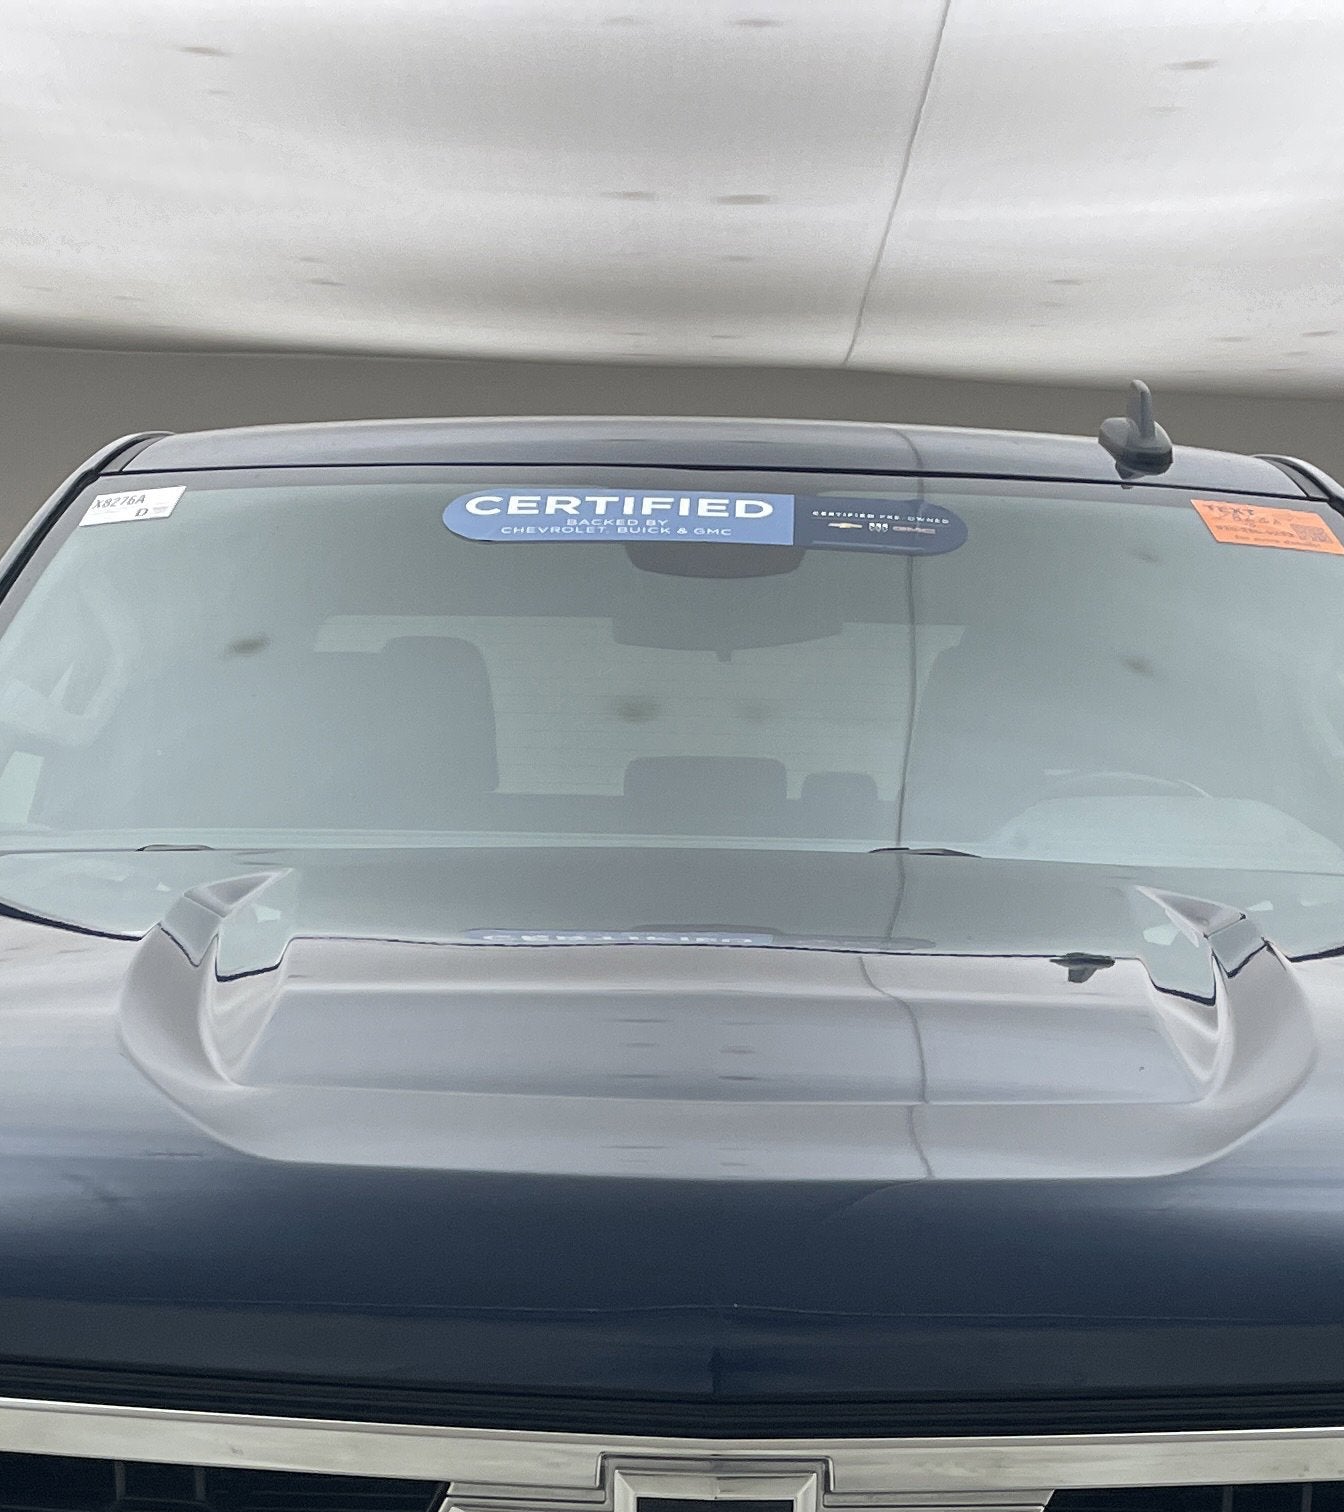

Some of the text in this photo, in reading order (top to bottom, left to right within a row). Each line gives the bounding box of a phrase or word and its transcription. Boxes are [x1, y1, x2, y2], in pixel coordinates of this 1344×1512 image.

[465, 495, 774, 518] CERTIFIED
[566, 518, 669, 527] BACKED BY
[617, 526, 671, 535] BUICK
[693, 528, 732, 536] GMC
